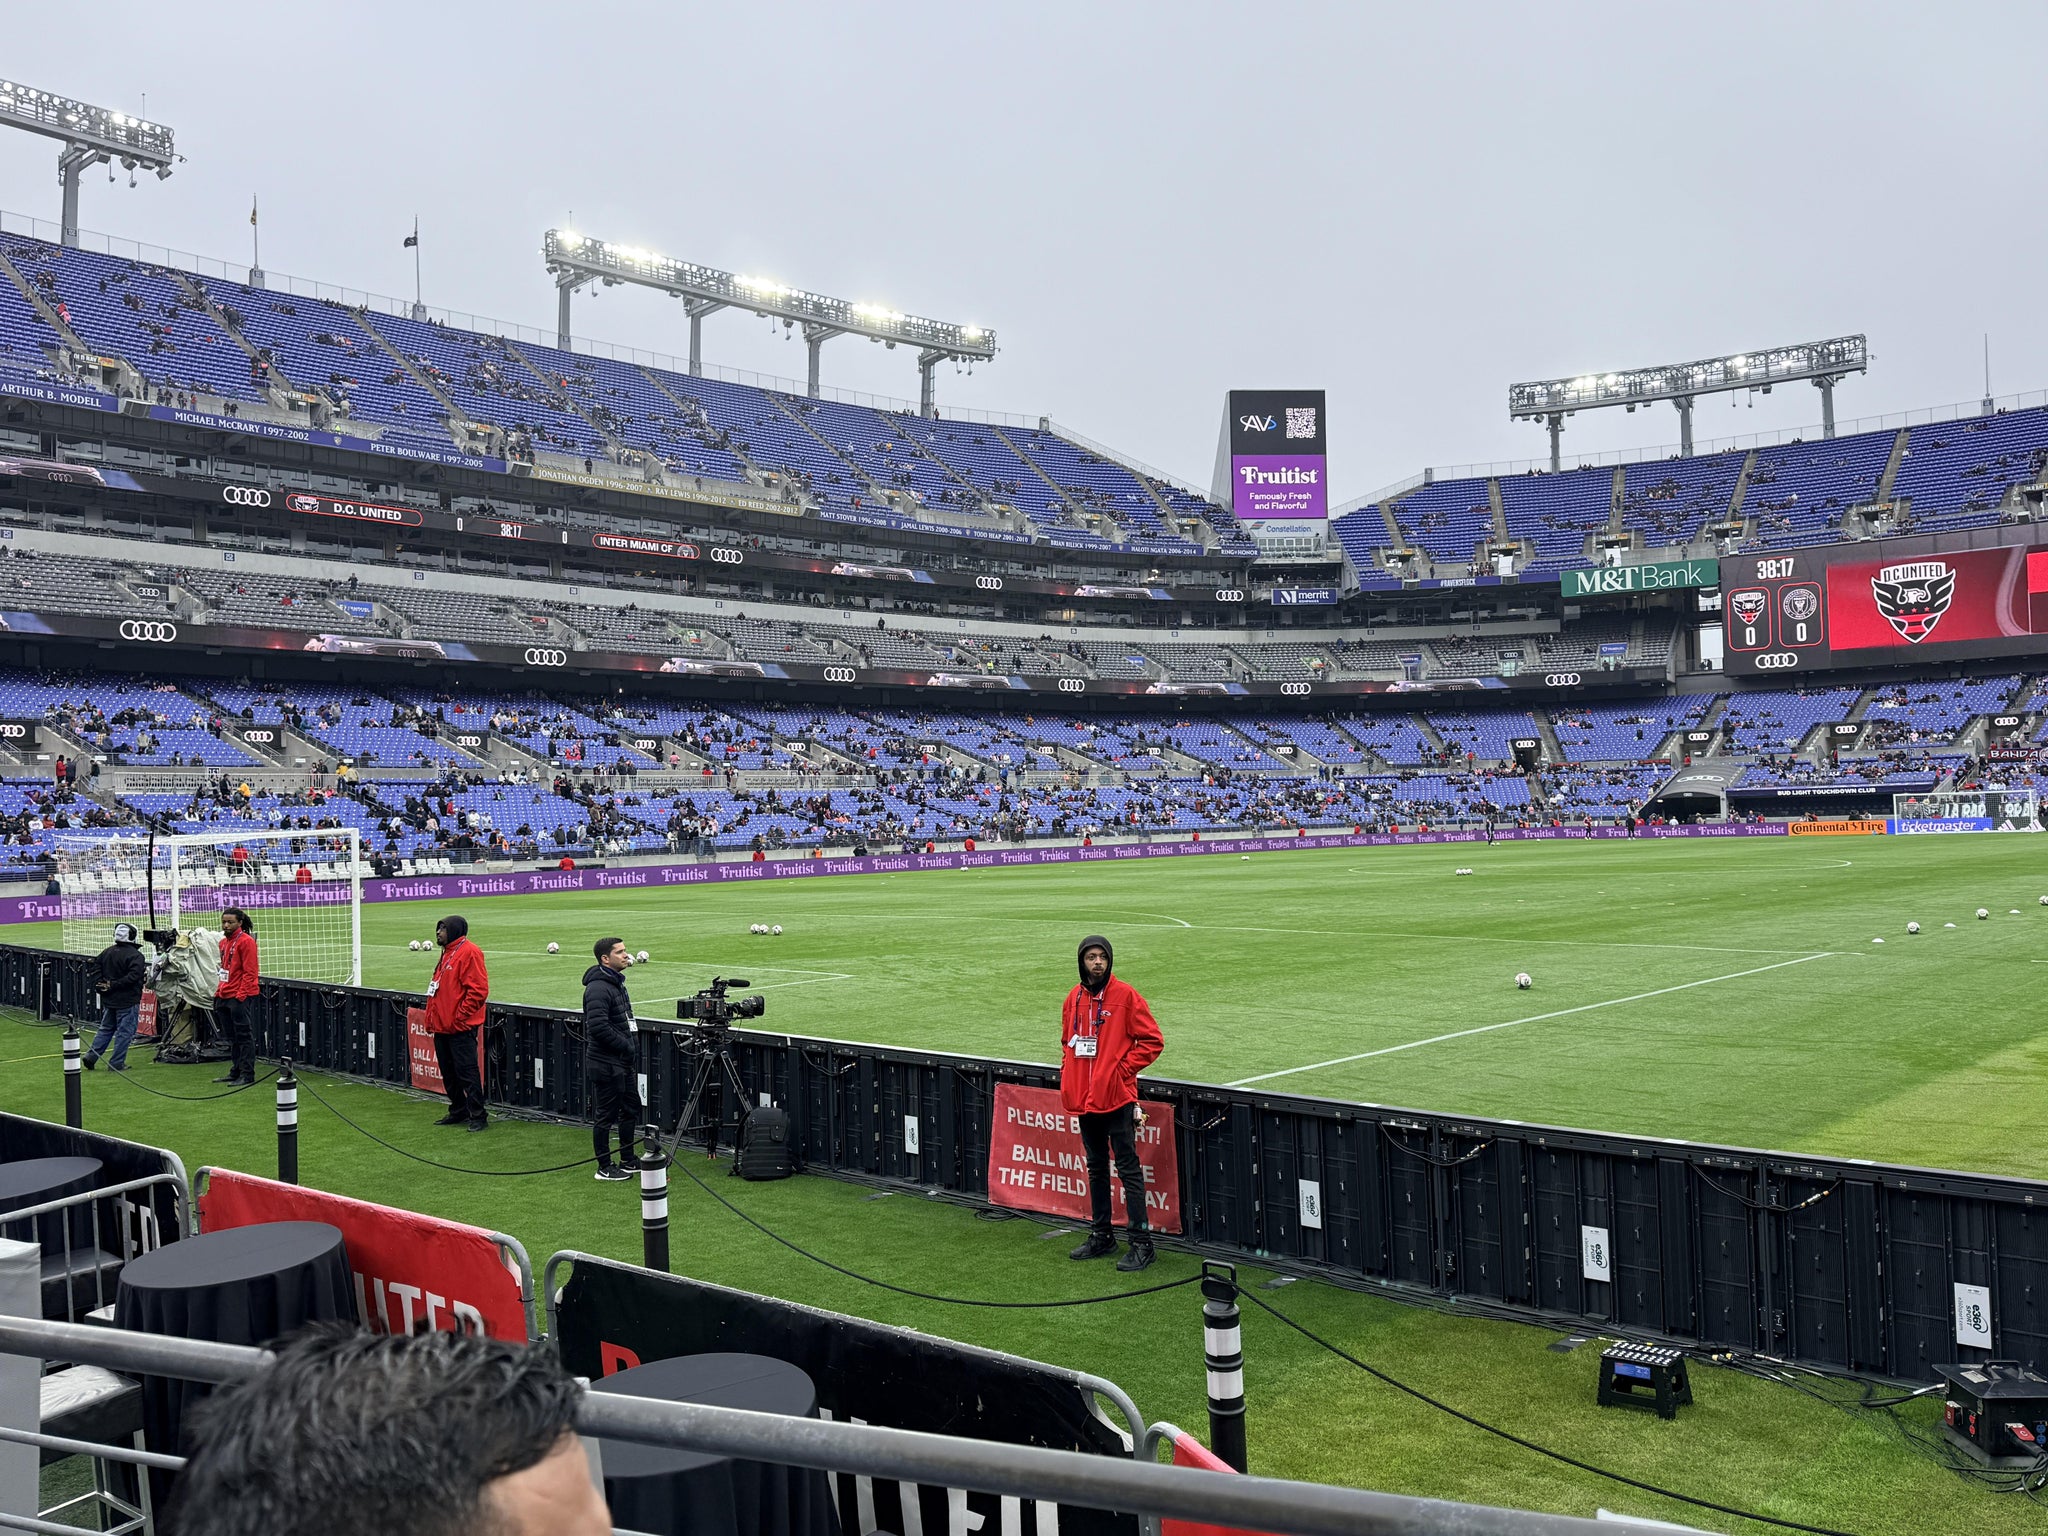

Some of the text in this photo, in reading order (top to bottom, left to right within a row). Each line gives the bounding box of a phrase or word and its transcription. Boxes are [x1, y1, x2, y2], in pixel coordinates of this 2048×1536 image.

[1, 383, 102, 408] ARTHUR B. MODELL
[175, 412, 309, 441] MICHAEL McCRARY 1997-2002
[370, 443, 484, 468] PETER BOULWARE 1997-2005
[1240, 466, 1318, 484] Fruitist
[538, 470, 577, 482] JONATHAN
[579, 476, 604, 486] OGDEN
[606, 480, 644, 492] 1996-2007
[656, 488, 668, 496] RAY
[670, 490, 690, 499] LEWIS
[748, 502, 764, 510] REED
[766, 504, 798, 514] 2002-2012
[1250, 492, 1286, 502] Famously
[1254, 502, 1307, 510] and Flavorful
[334, 502, 463, 532] D.C. UNITED 0
[500, 524, 568, 544] 38:17 0
[1266, 524, 1312, 534] Constellation
[600, 536, 673, 553] INTER MIAMI CF
[1757, 558, 1794, 580] 38:17
[1576, 562, 1702, 594] M&T Bank
[1298, 590, 1329, 600] merritt
[1746, 627, 1756, 646] 0
[1796, 623, 1806, 642] 0
[1652, 826, 1689, 836] Fruitist
[1698, 825, 1736, 836] Fruitist
[1745, 824, 1784, 835] Fruitist
[1792, 822, 1884, 834] Continental Tire
[1902, 820, 1976, 832] ticketmaster
[1372, 834, 1391, 844] Fruitist
[1394, 834, 1414, 844] Fruitist
[1418, 833, 1436, 843] Fruitist
[1444, 831, 1476, 842] Fruitist
[1522, 828, 1556, 838] Fruitist
[1240, 840, 1263, 850] Fruitist
[1268, 839, 1290, 850] Fruitist
[1294, 838, 1316, 848] Fruitist
[1320, 836, 1342, 846] Fruitist
[1347, 835, 1368, 846] Fruitist
[1114, 846, 1140, 857] Fruitist
[1147, 844, 1174, 856] Fruitist
[1179, 844, 1204, 854] Fruitist
[1210, 842, 1234, 852] Fruitist
[1001, 852, 1032, 864] Fruitist
[1040, 850, 1070, 861] Fruitist
[1078, 848, 1107, 859] Fruitist
[872, 858, 909, 870] Fruitist
[918, 856, 952, 868] Fruitist
[960, 854, 994, 866] Fruitist
[719, 865, 763, 878] Fruitist
[774, 863, 814, 876] Fruitist
[824, 860, 864, 873] Fruitist
[596, 871, 647, 886] Fruitist
[662, 868, 708, 882] Fruitist
[458, 878, 516, 894] Fruitist
[530, 874, 584, 890] Fruitist
[300, 886, 365, 902] Fruitit
[382, 882, 444, 898] Fruitist
[213, 890, 282, 907] Fruitist
[414, 1048, 430, 1062] BALL
[412, 1062, 424, 1076] THE
[1008, 1106, 1161, 1145] PLEASE B RT!
[1012, 1144, 1056, 1167] BALL
[999, 1167, 1036, 1188] THE
[1042, 1173, 1087, 1196] FIELD
[1972, 1304, 1982, 1330] e360
